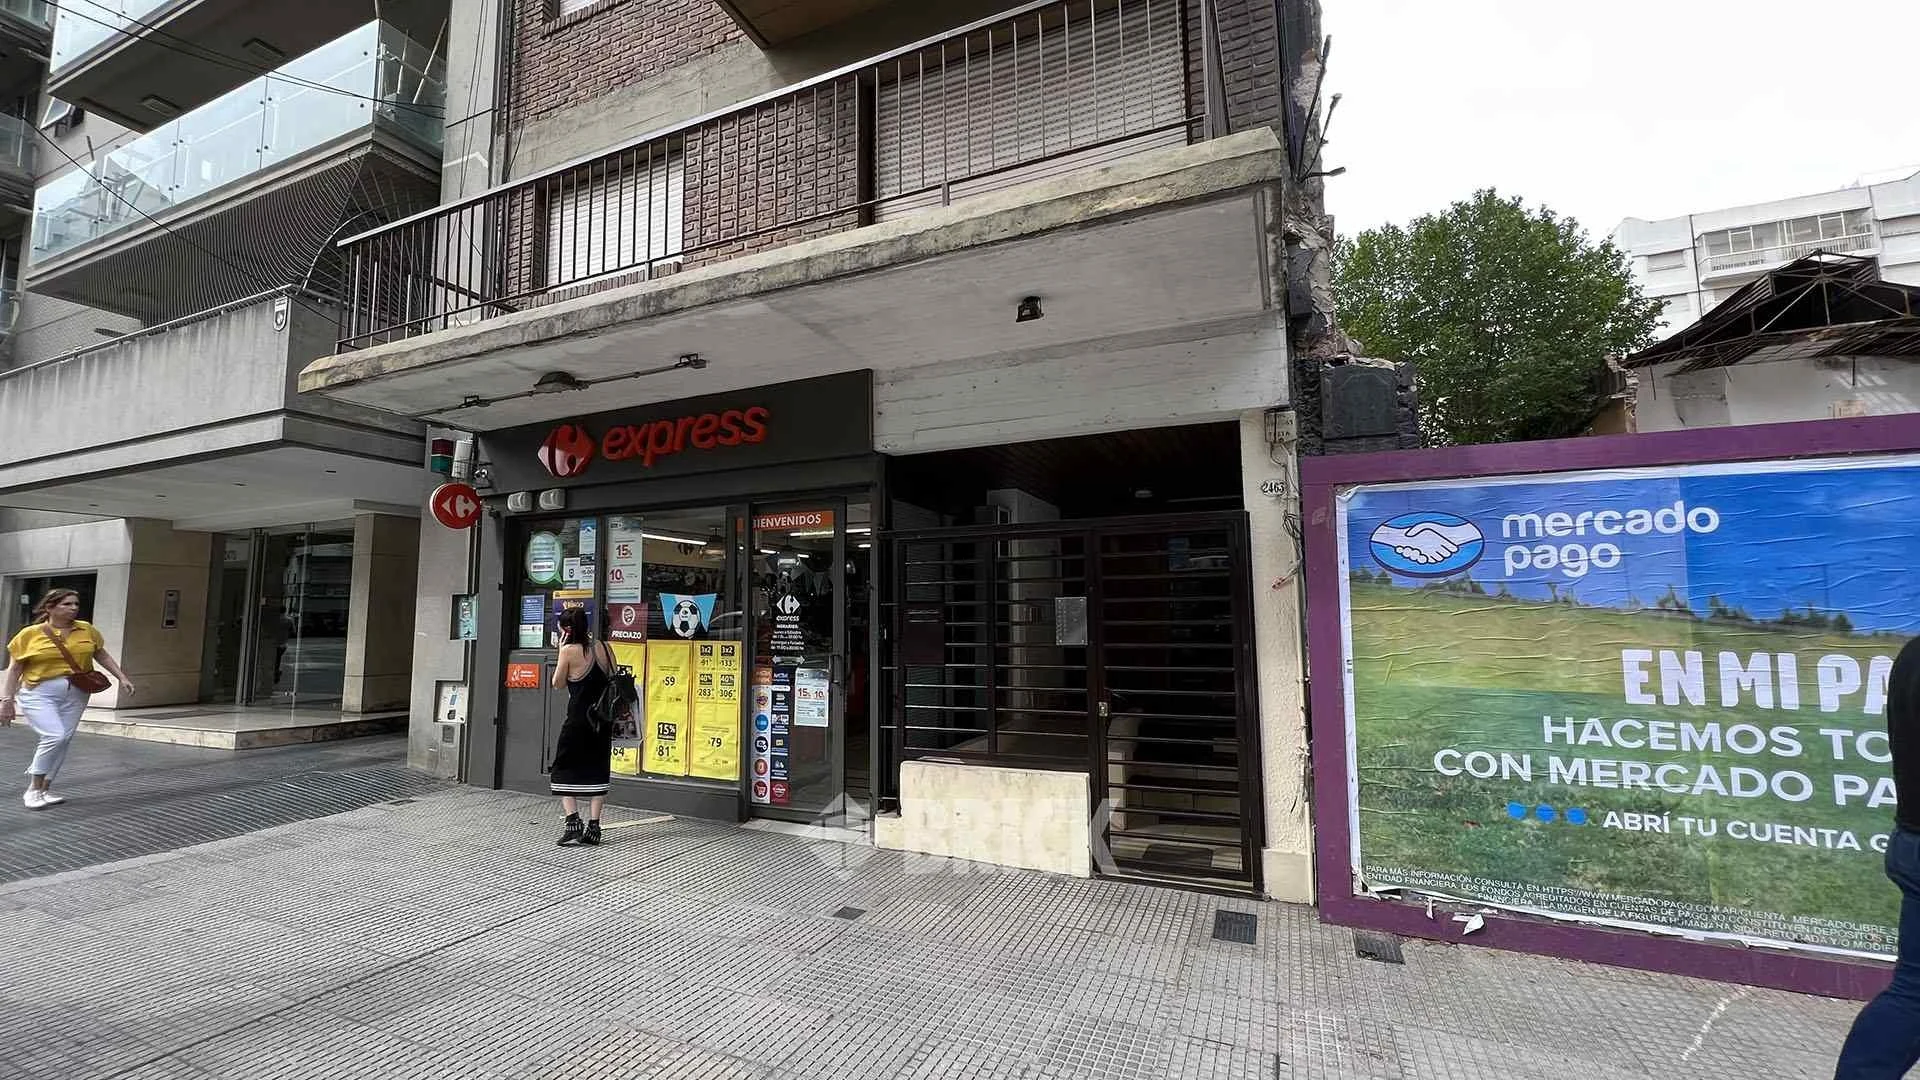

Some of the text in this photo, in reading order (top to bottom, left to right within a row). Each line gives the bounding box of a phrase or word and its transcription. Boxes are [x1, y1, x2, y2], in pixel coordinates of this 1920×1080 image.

[602, 406, 769, 467] express
[1260, 481, 1285, 494] 2463
[1502, 500, 1719, 538] mercado
[1504, 543, 1621, 578] pago
[611, 630, 642, 640] PRECIAZO
[1621, 649, 1893, 715] EN MI PA
[1543, 715, 1803, 757] HACEMOS
[1434, 748, 1898, 808] CON MERCADO PA
[1602, 811, 1671, 833] ABRÍ
[1678, 816, 1717, 836] TU
[1726, 821, 1861, 851] CUENTA
[1366, 864, 1388, 873] PARA
[1366, 872, 1402, 882] ENTIDAD
[1461, 882, 1478, 891] LOS
[1481, 885, 1520, 897] FONDOS
[1593, 899, 1606, 907] EN
